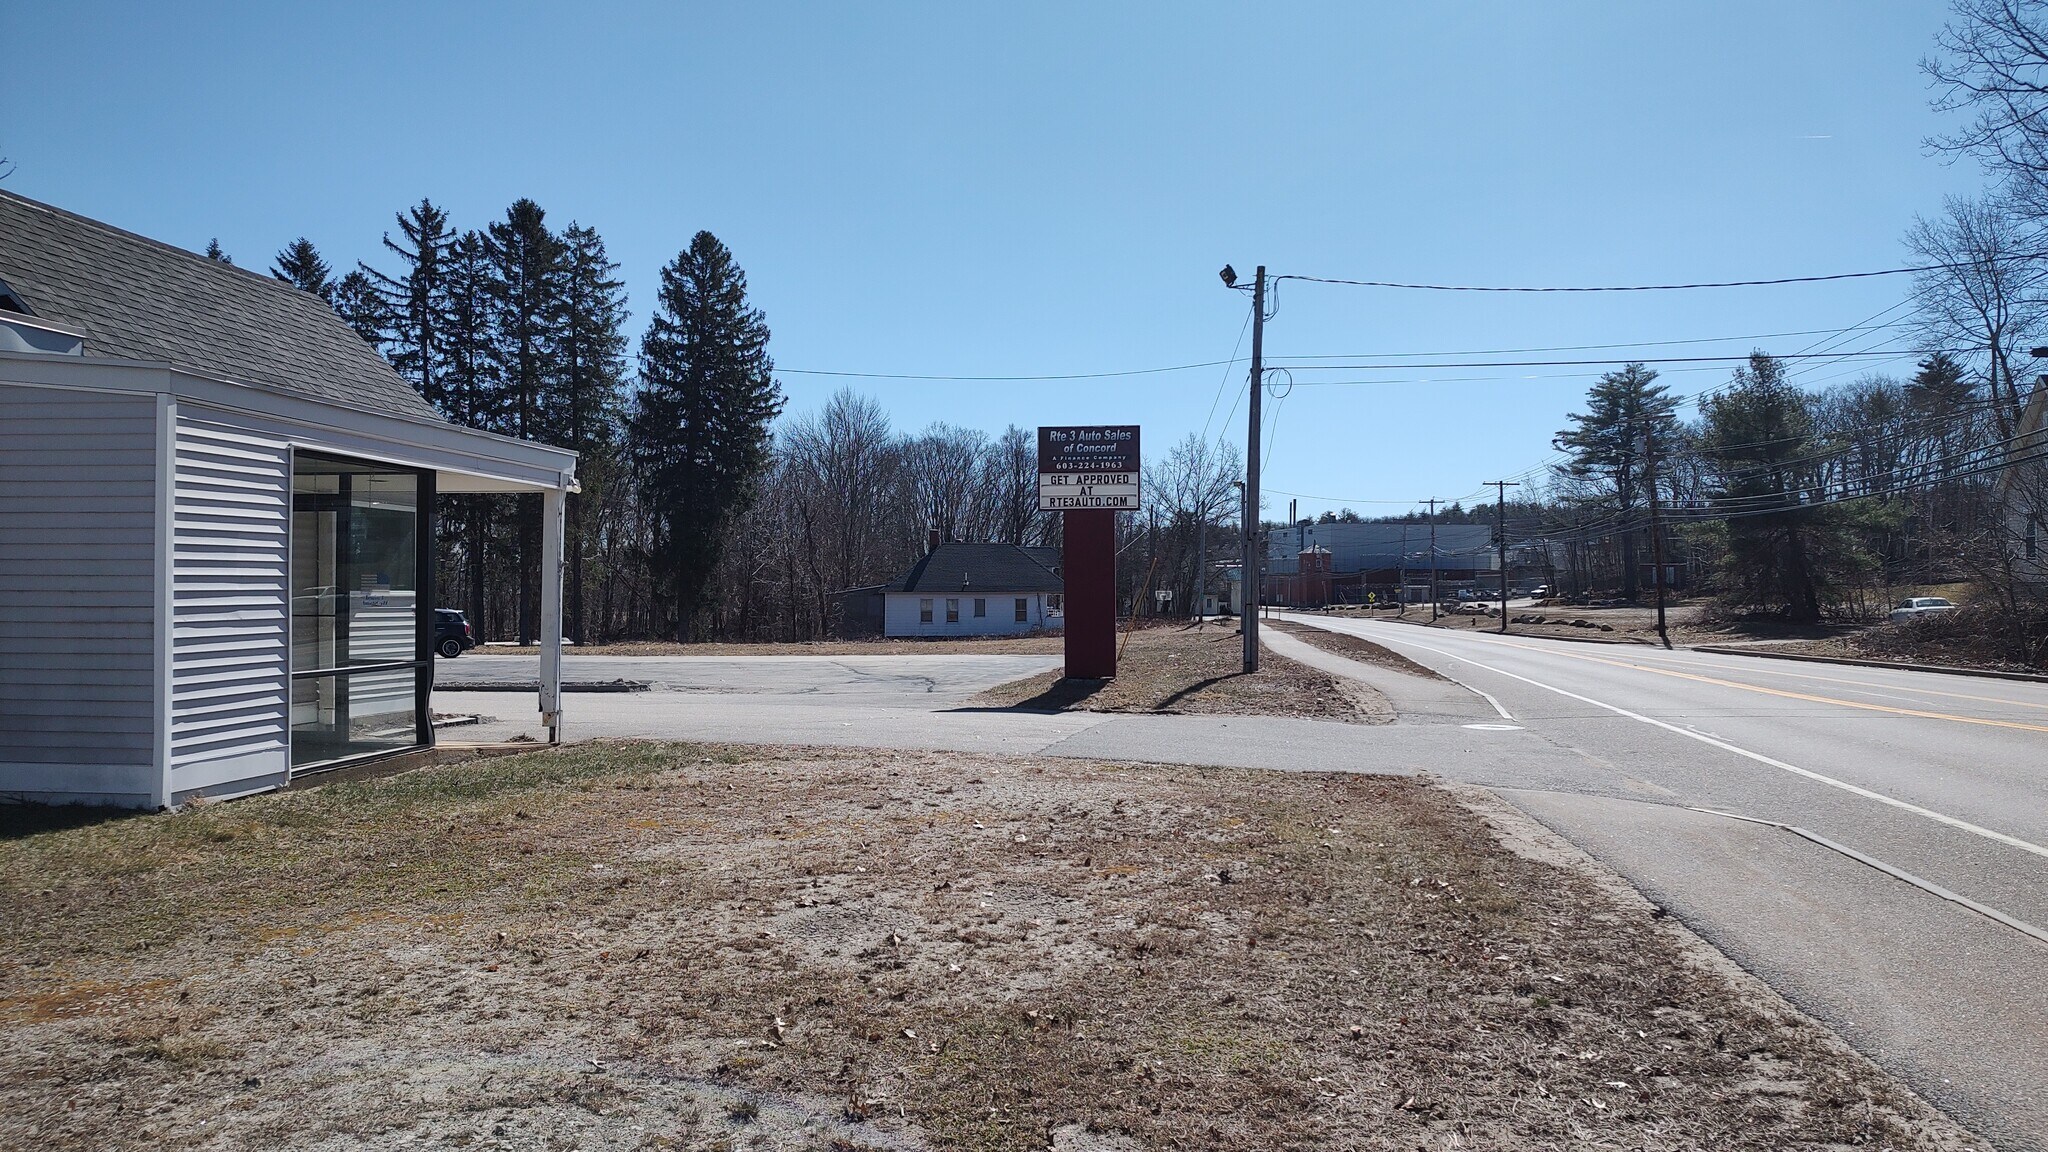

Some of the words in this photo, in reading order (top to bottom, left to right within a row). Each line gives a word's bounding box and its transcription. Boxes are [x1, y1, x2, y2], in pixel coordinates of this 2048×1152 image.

[1049, 430, 1067, 442] Rte
[1069, 430, 1076, 441] 3
[1078, 430, 1101, 441] Auto
[1104, 429, 1132, 441] Sales
[1063, 443, 1074, 453] of
[1076, 443, 1117, 453] Concord
[1056, 461, 1122, 469] 603-224-1963
[1050, 475, 1069, 485] GET
[1076, 474, 1129, 485] APPROVED
[1080, 486, 1093, 496] AT
[1049, 497, 1128, 507] RTE3AUTO.COM
